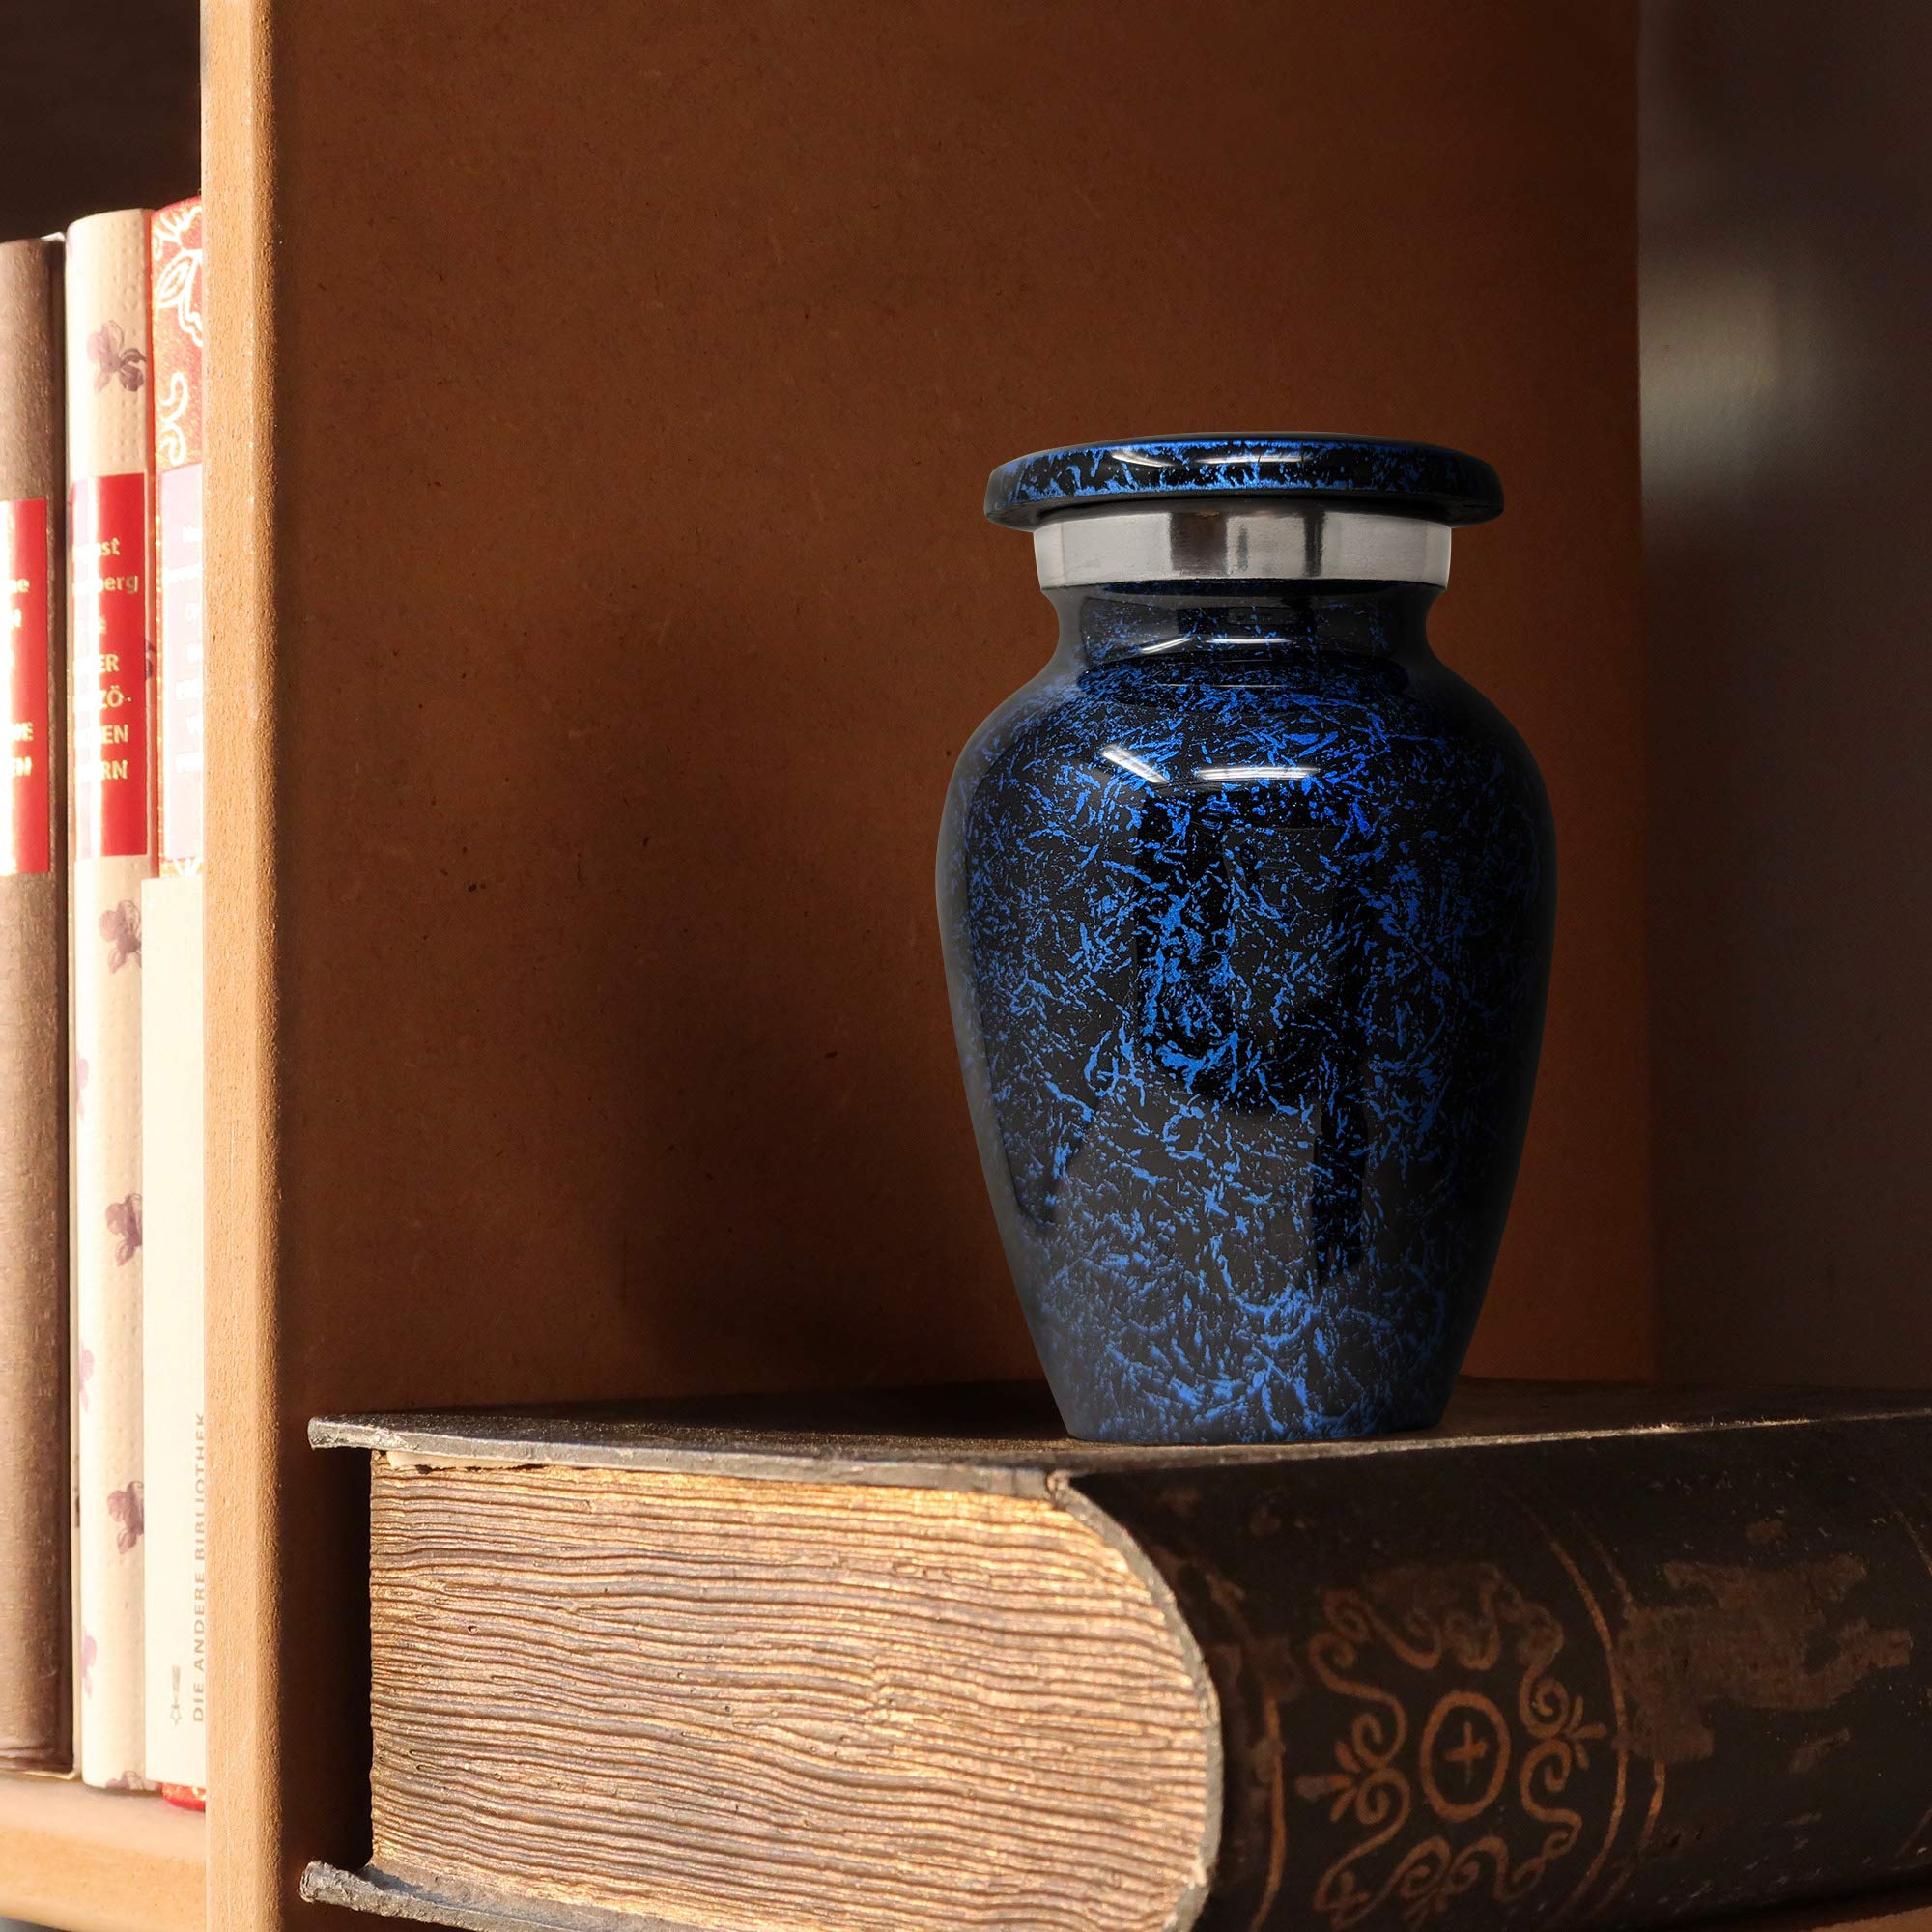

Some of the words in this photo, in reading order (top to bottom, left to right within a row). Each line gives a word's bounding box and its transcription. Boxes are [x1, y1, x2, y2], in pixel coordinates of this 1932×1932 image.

[194, 1411, 205, 1562] BIBLIOTHEK
[193, 1572, 205, 1672] ANDERE
[192, 1683, 205, 1722] DIE
